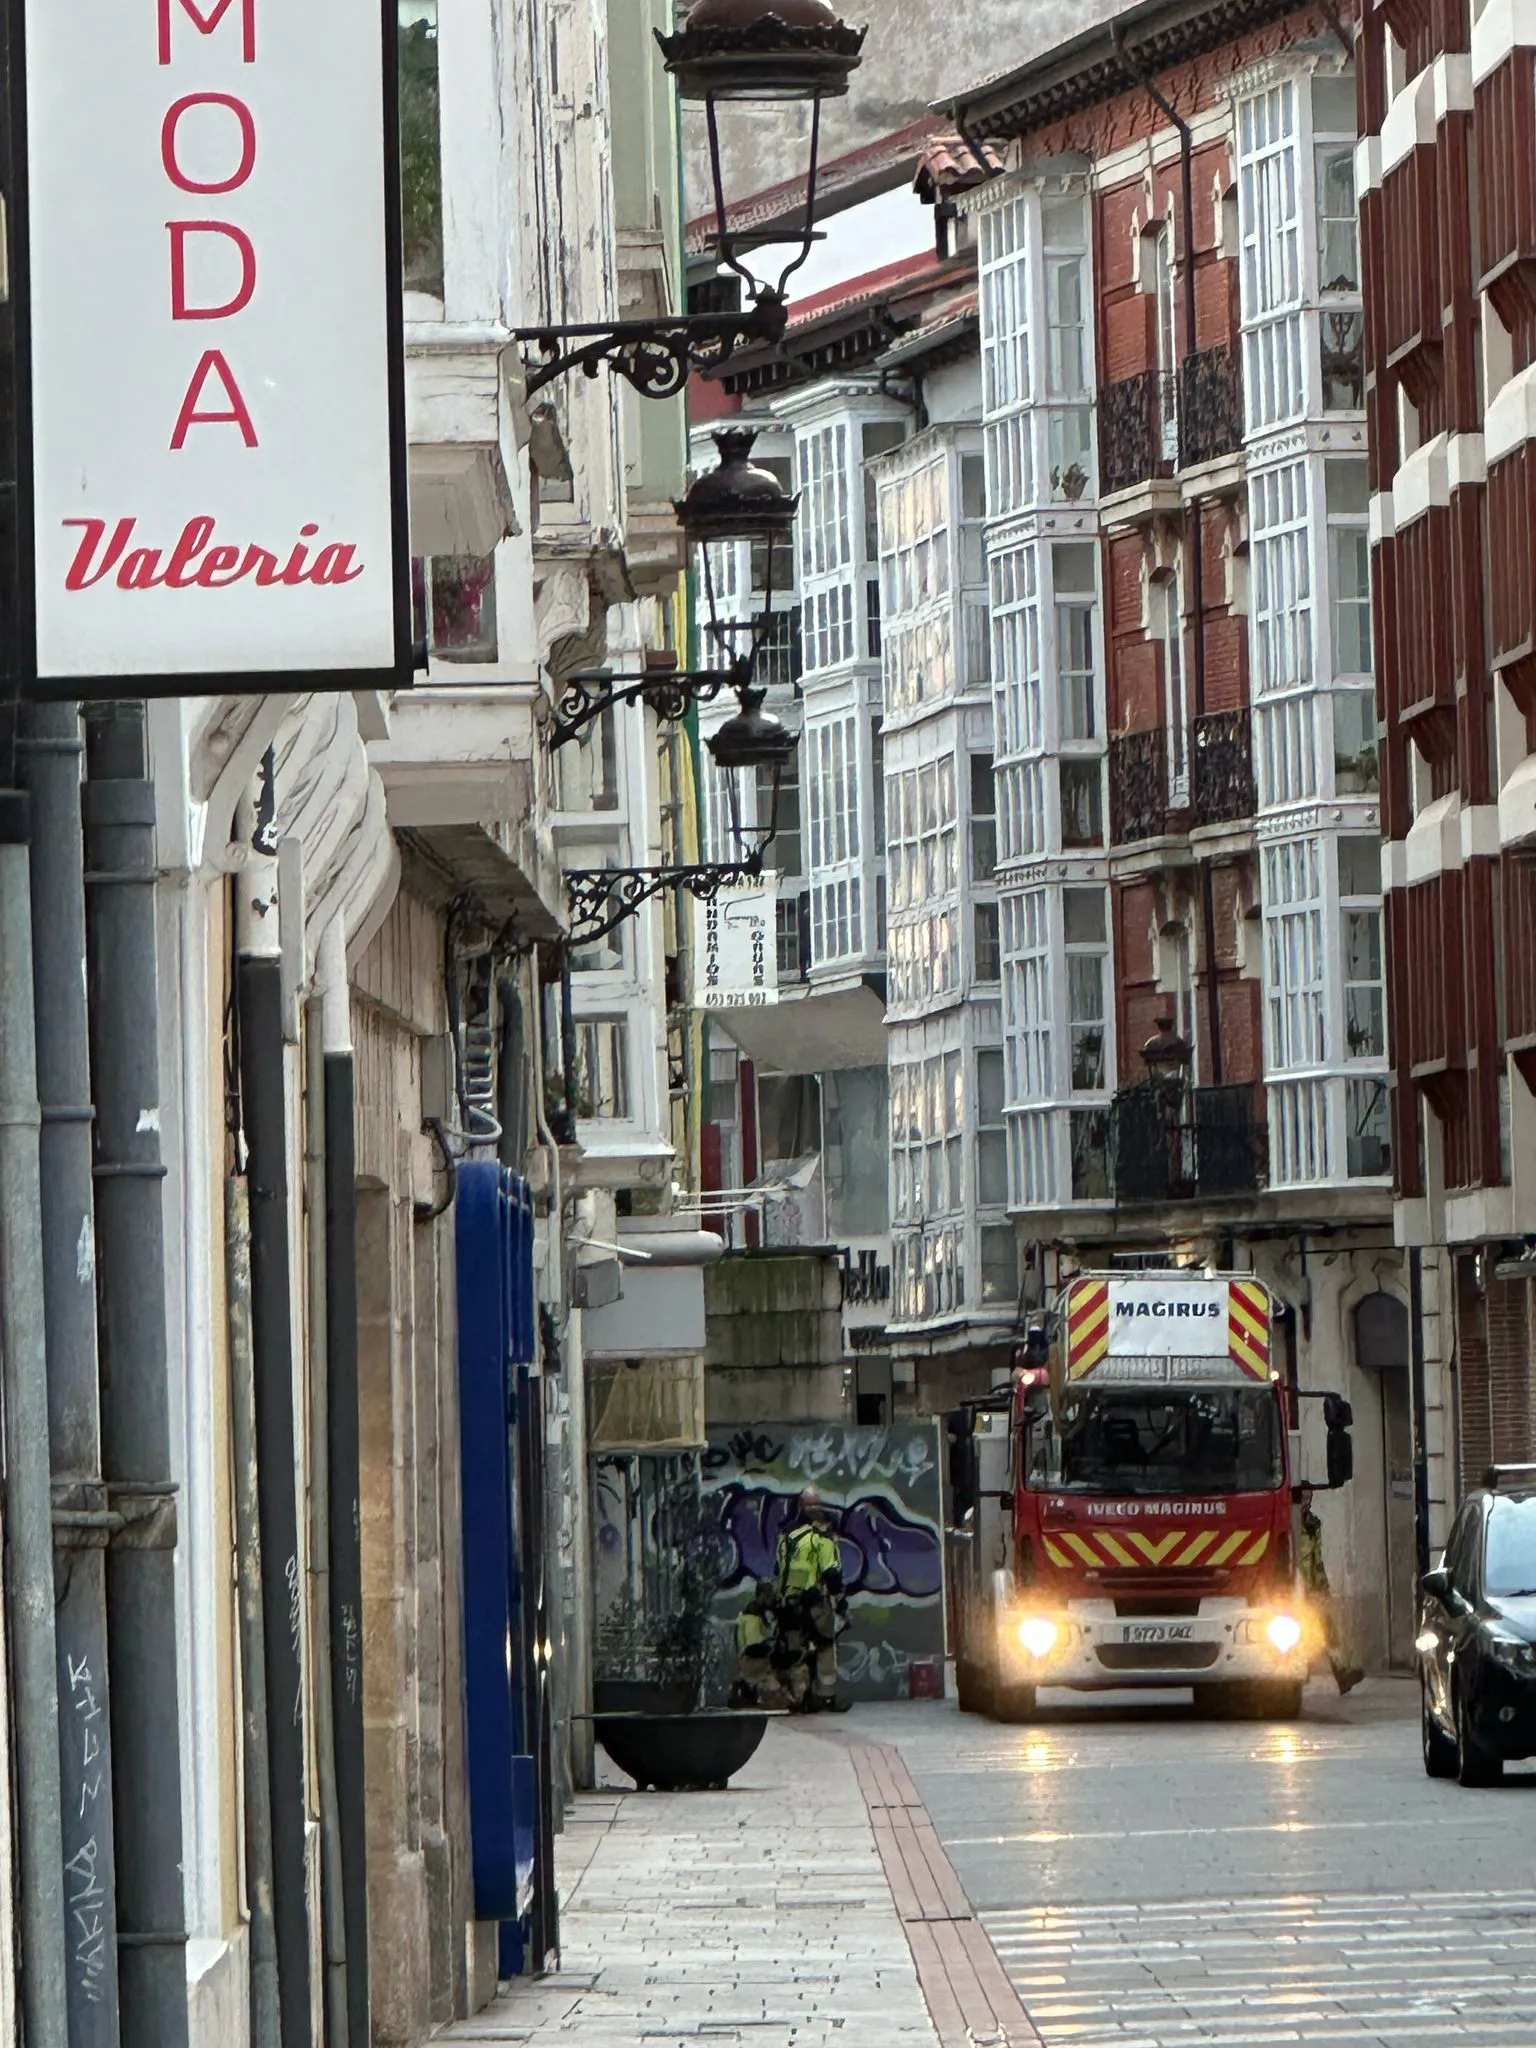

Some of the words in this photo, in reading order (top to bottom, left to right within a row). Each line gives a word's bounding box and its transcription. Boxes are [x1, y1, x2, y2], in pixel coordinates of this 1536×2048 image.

[157, 0, 259, 451] MODA
[61, 514, 364, 591] Valeria
[1115, 1301, 1221, 1318] MAGIRUS
[1087, 1502, 1140, 1516] IVECO
[1144, 1502, 1227, 1515] MAGIRUS
